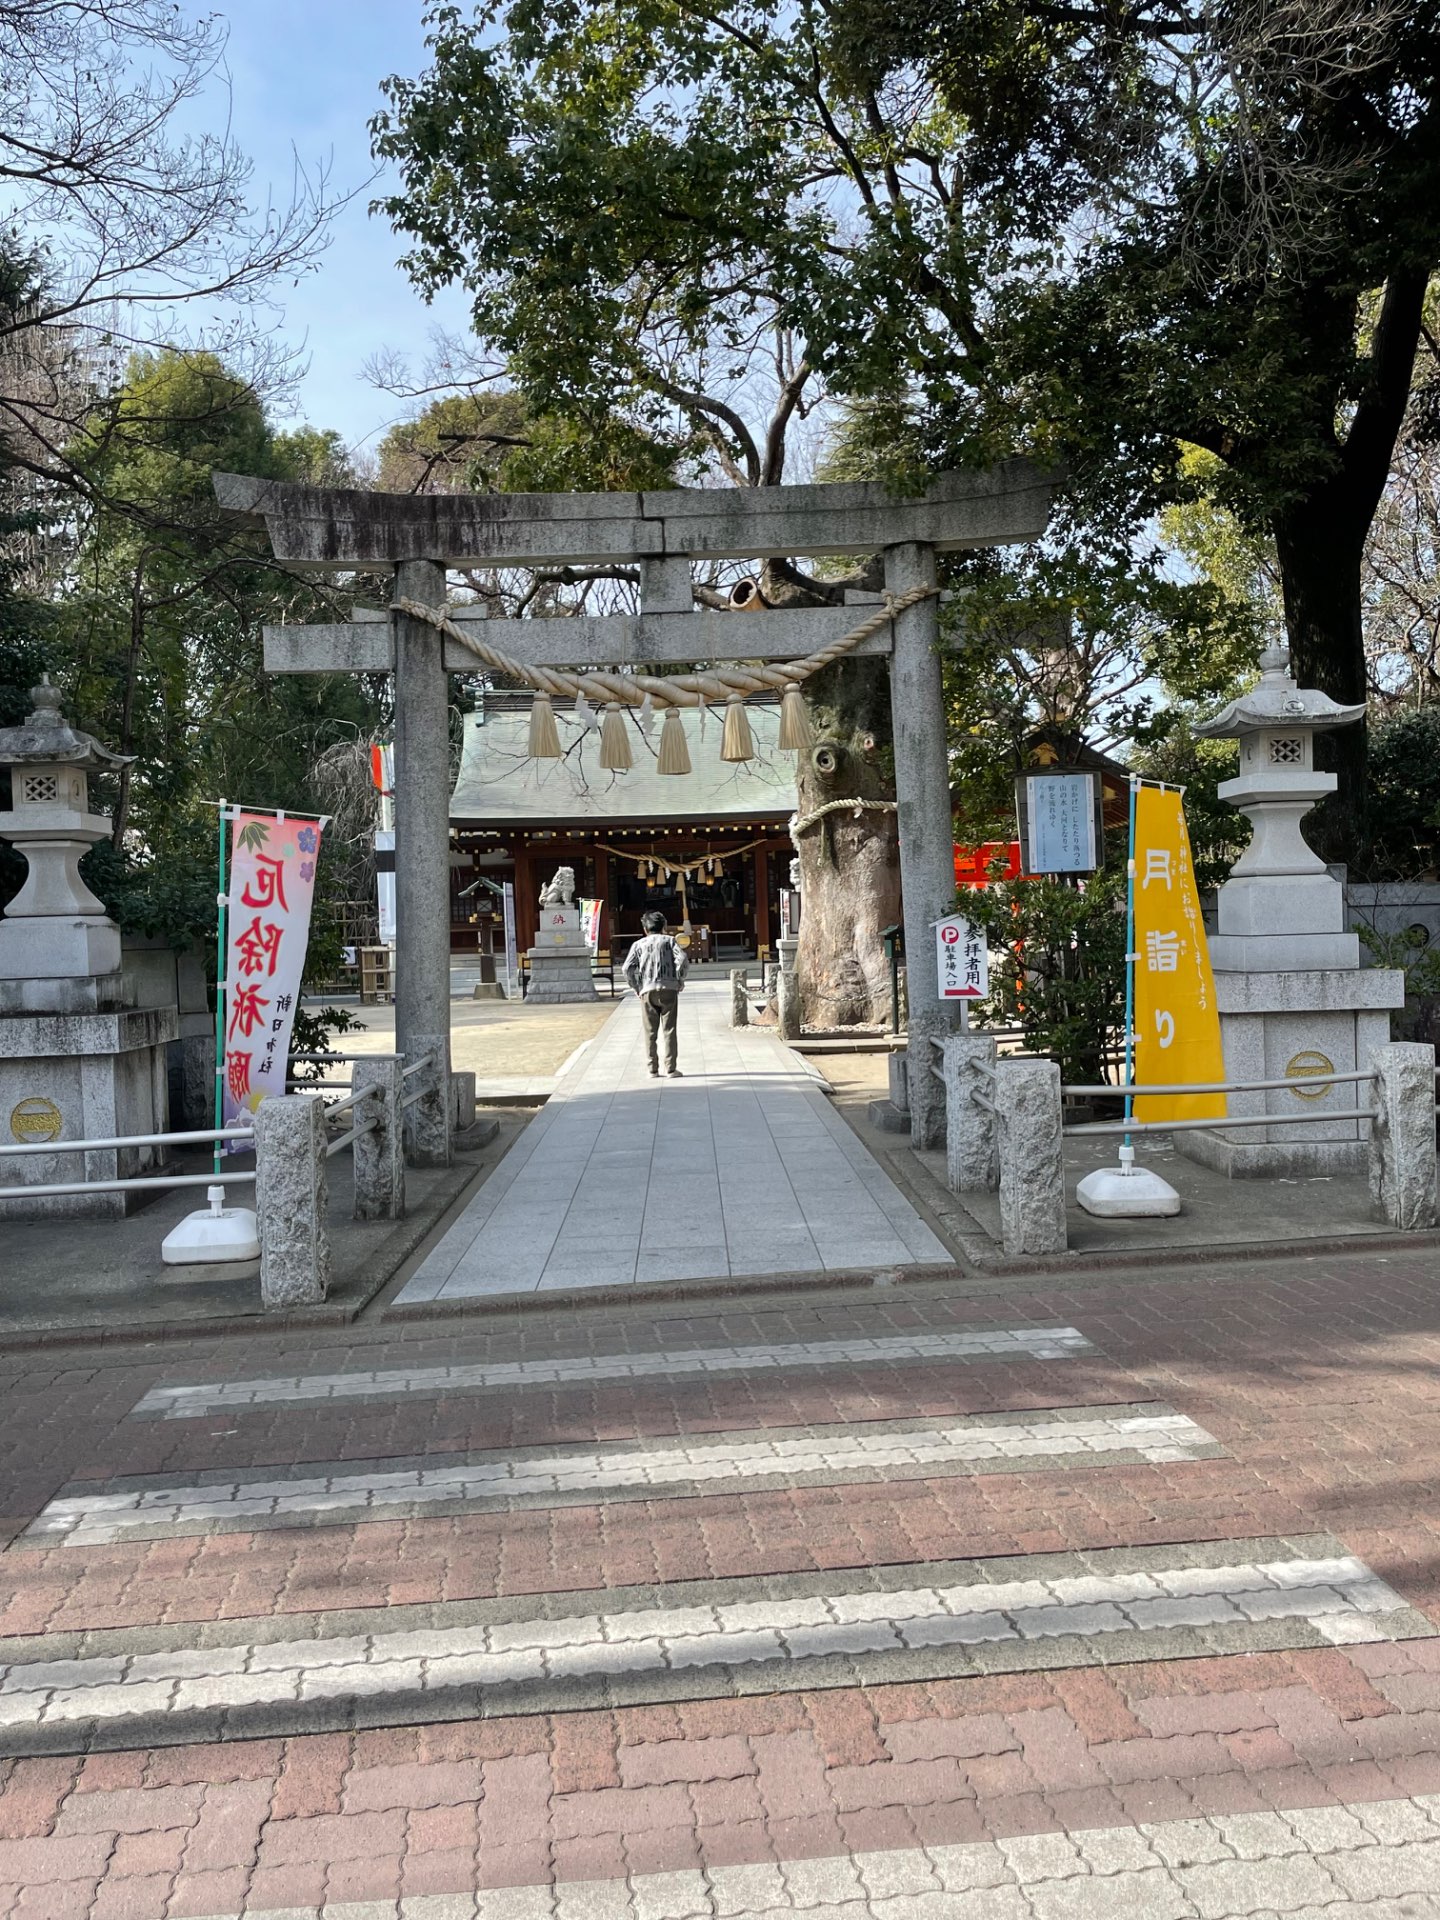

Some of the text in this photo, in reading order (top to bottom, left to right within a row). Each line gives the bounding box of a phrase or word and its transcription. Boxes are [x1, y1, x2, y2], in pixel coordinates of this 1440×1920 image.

[552, 914, 566, 925] 納
[945, 928, 957, 943] P
[944, 945, 958, 987] 駐車場入口
[963, 922, 983, 985] 参拝者用
[1142, 849, 1179, 1049] 月詣り
